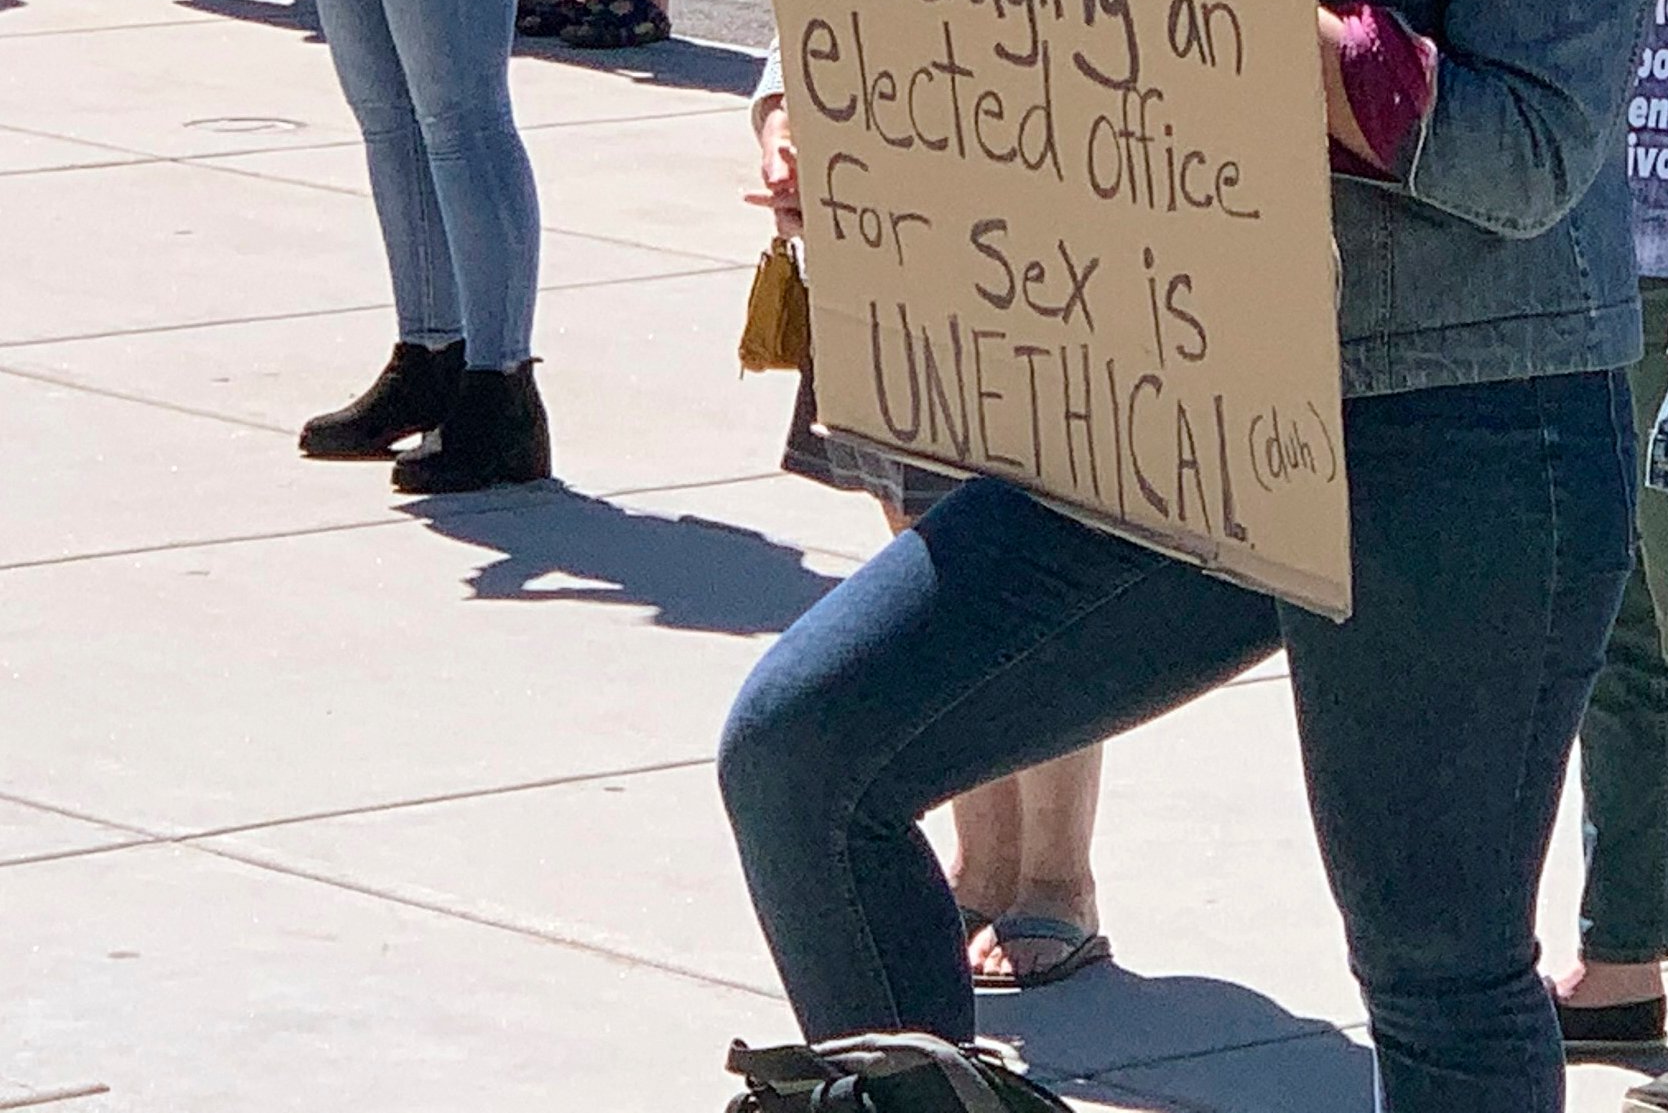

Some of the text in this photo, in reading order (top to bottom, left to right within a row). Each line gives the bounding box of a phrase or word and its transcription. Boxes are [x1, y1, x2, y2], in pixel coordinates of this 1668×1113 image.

[802, 11, 1062, 181] elected
[820, 152, 932, 266] for
[1143, 247, 1207, 369] is
[1248, 401, 1338, 492] (duh)
